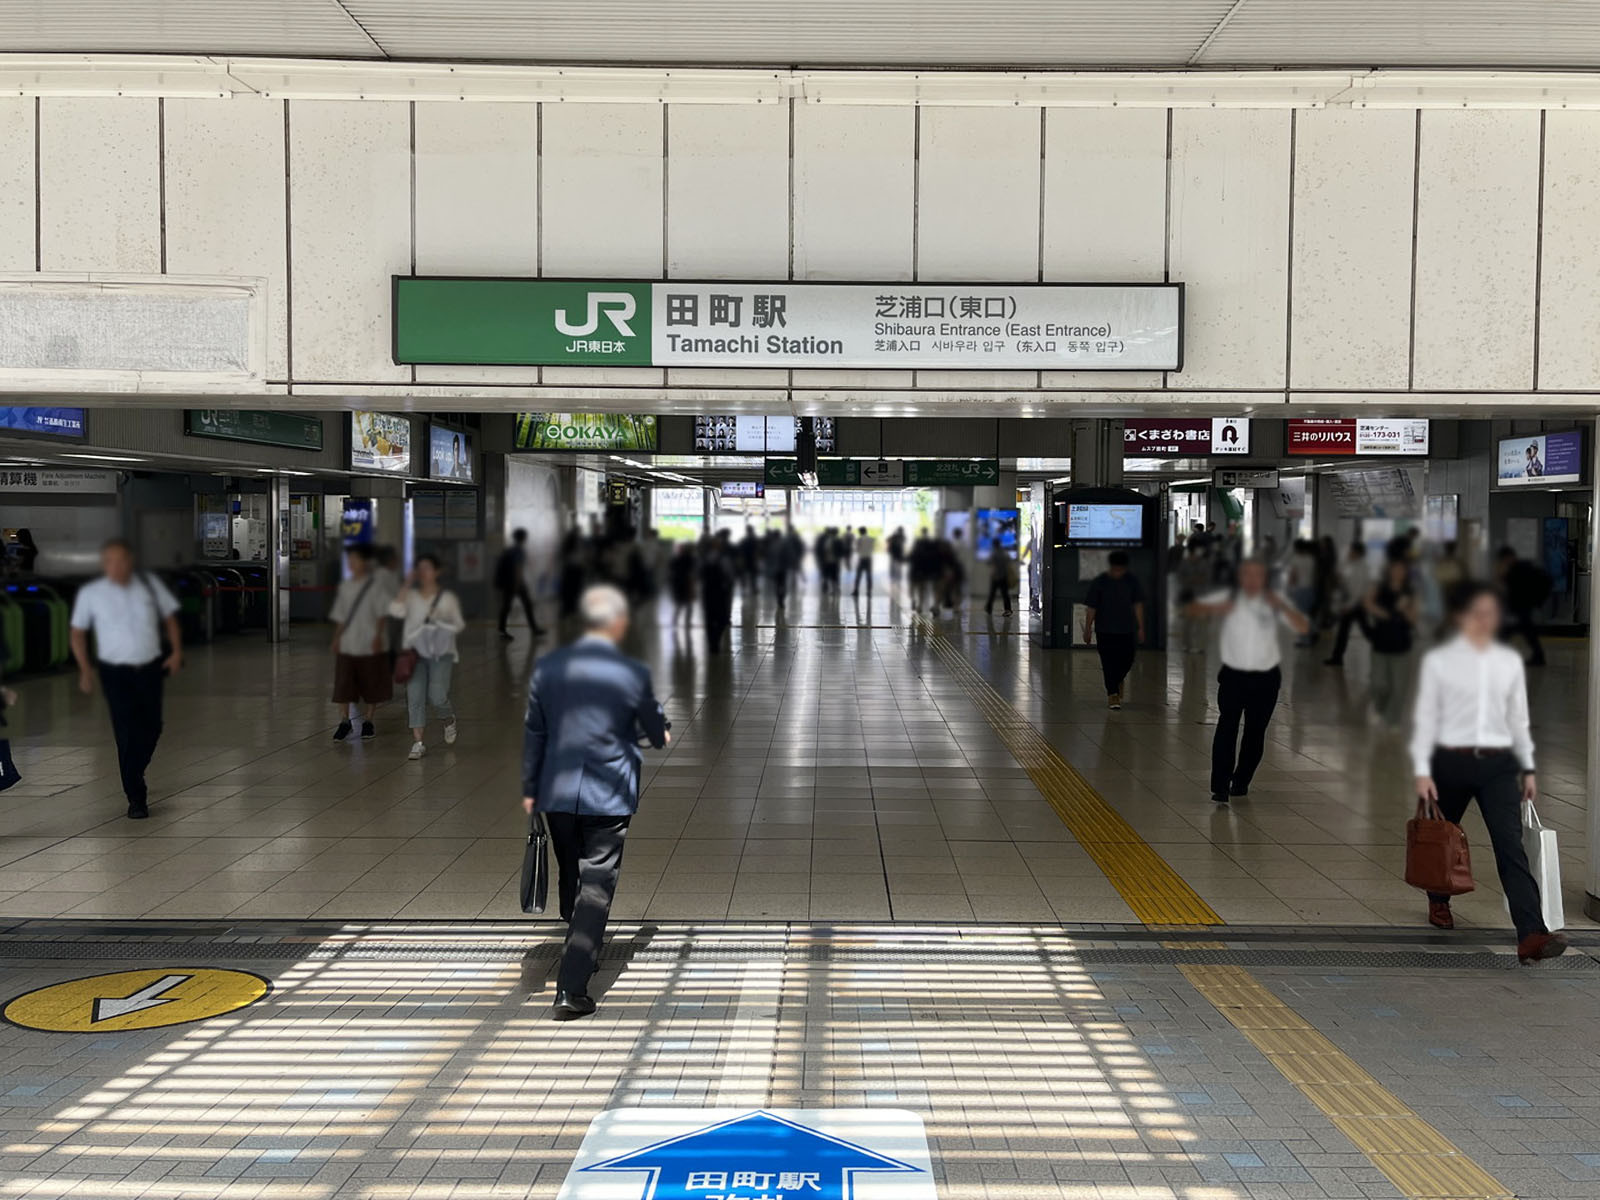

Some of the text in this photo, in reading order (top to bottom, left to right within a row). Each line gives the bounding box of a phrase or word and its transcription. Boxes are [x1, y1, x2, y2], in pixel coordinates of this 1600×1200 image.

[555, 292, 636, 336] JR
[667, 294, 787, 328] 田町駅
[874, 322, 1112, 337] Shibaura Entrance (East Entrance)
[566, 340, 626, 354] JR東日本
[667, 334, 843, 354] Tamachi Station
[874, 339, 921, 352] 芝浦入口
[563, 426, 629, 440] OKAYA
[1138, 429, 1210, 441] くまざわ書店
[1293, 431, 1352, 442] 三井のリハウス
[962, 463, 981, 474] JR
[685, 1172, 822, 1191] 田町駅
